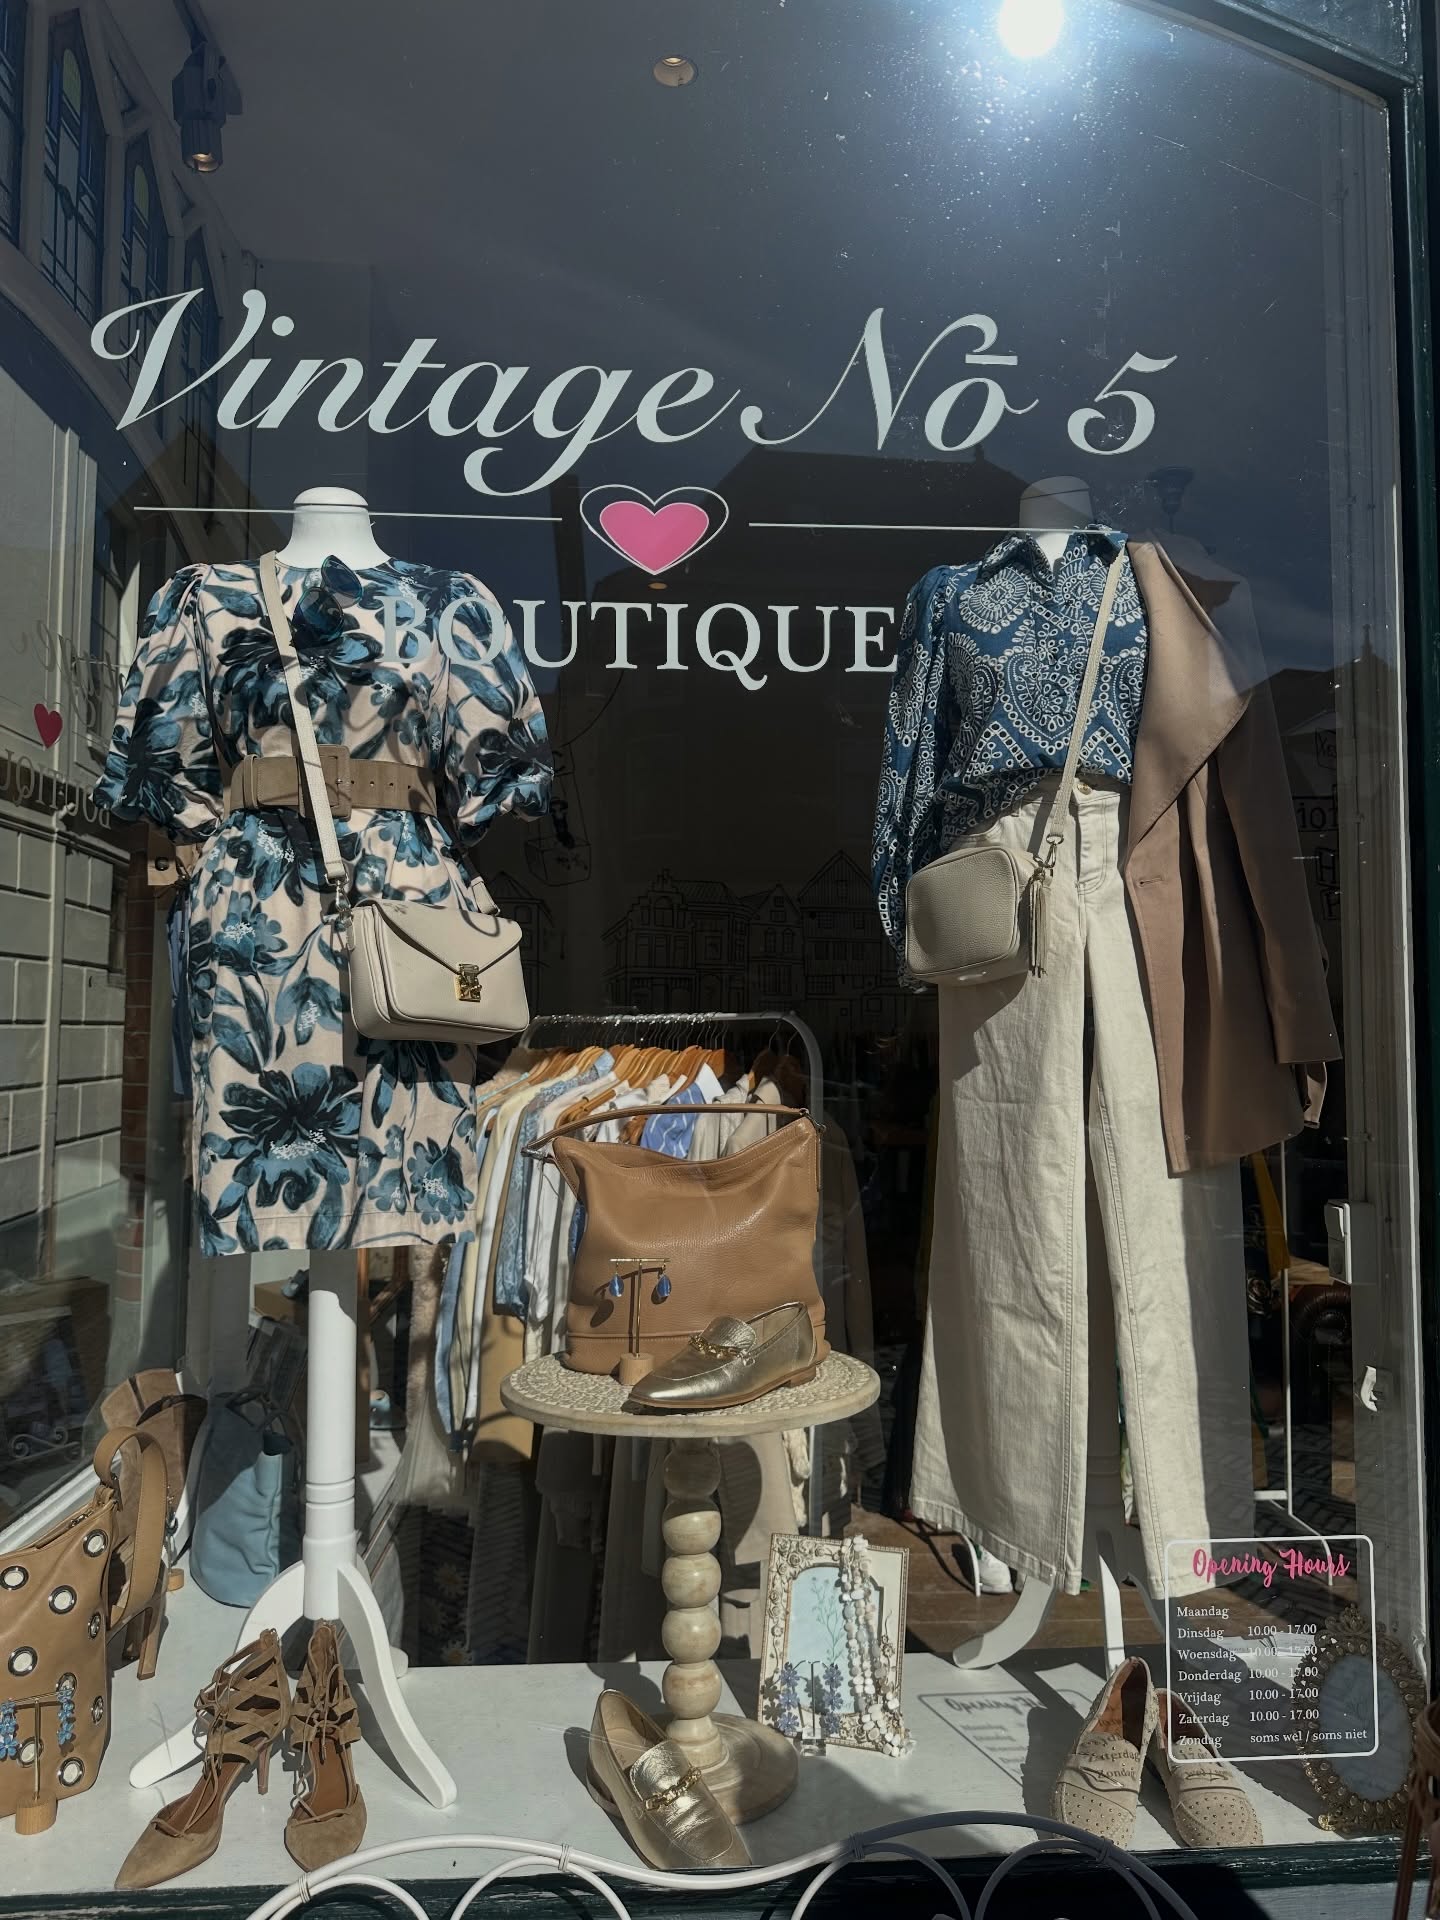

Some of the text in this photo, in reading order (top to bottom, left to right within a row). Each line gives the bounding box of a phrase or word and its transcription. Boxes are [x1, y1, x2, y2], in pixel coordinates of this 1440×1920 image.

[90, 287, 741, 496] Vintage
[1067, 350, 1178, 455] 5
[372, 595, 899, 691] BOUTIQUE
[1192, 1548, 1350, 1588] Opening Hours
[1176, 1605, 1230, 1619] Maandag
[1177, 1627, 1225, 1641] Dinsdag
[1247, 1625, 1277, 1637] 10.00
[1287, 1623, 1317, 1635] 17.00
[1177, 1648, 1237, 1662] Woensdag
[1248, 1646, 1278, 1657] 10.00
[1178, 1669, 1242, 1684] Donderdag
[1248, 1668, 1278, 1679] 10.00
[1289, 1666, 1319, 1678] 17.00
[1178, 1691, 1222, 1706] Vrijdag
[1249, 1689, 1279, 1701] 10.00
[1289, 1687, 1319, 1699] 17.00
[1178, 1712, 1230, 1727] Zaterdag
[1249, 1710, 1280, 1722] 10.00
[1289, 1708, 1320, 1720] 17.00
[1179, 1734, 1223, 1748] Zondag
[1250, 1732, 1280, 1743] soms
[1283, 1730, 1303, 1742] wel
[1312, 1731, 1342, 1742] soms
[1344, 1729, 1368, 1740] niet
